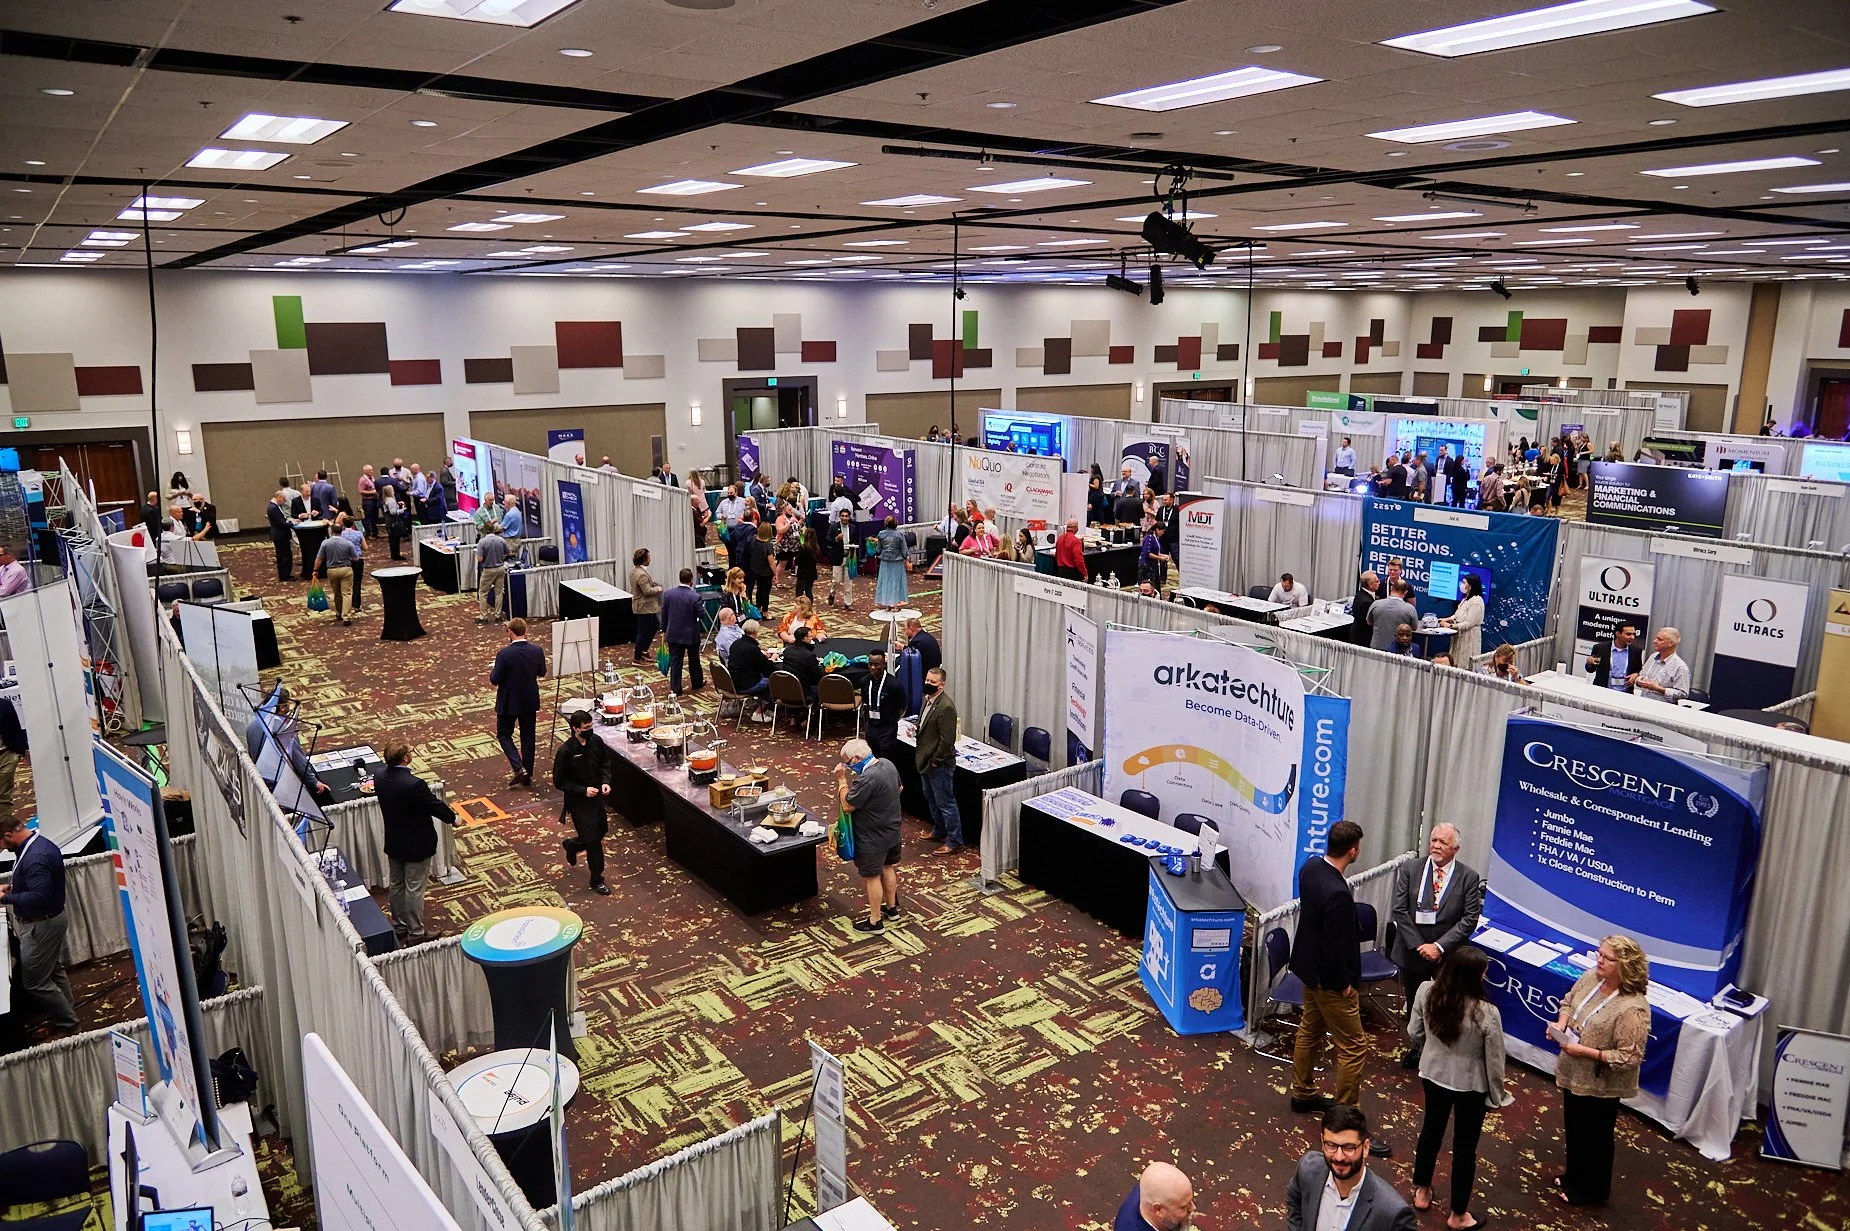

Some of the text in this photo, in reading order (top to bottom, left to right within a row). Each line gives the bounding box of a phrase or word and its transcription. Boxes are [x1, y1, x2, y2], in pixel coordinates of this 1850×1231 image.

[1728, 448, 1770, 456] MOMENTUM
[1594, 485, 1657, 498] MARKETING &
[1594, 492, 1640, 504] FINANCIAL
[1188, 510, 1215, 525] MDT
[1593, 500, 1676, 516] COMMUNICATIONS
[1371, 522, 1427, 540] BETTER
[1370, 535, 1454, 557] DECISIONS.
[1588, 590, 1640, 608] ULTRACS
[1595, 630, 1615, 639] platf
[1733, 621, 1784, 639] ULTRACS
[1154, 662, 1295, 731] arkatechture
[1185, 699, 1282, 743] Become Data-Driven.
[1523, 741, 1685, 804] CRESCENT
[1304, 718, 1334, 859] hture.com
[1609, 786, 1675, 811] MORTGAGE
[1518, 780, 1713, 847] Wholesale & Correspondent Lending
[1543, 809, 1575, 825] Jumbo
[1541, 820, 1594, 844] Fannie Mae
[1540, 832, 1595, 856] Freddie Mac
[1538, 842, 1558, 857] FHA
[1566, 851, 1579, 864] VA
[1587, 858, 1615, 875] USDA
[1538, 854, 1676, 908] 1x Close Construction to Perm
[1782, 1053, 1846, 1075] CRESCENT
[1790, 1077, 1814, 1086] FANNIE
[1789, 1091, 1816, 1100] FREDDIE
[346, 1183, 376, 1231] Multipl
